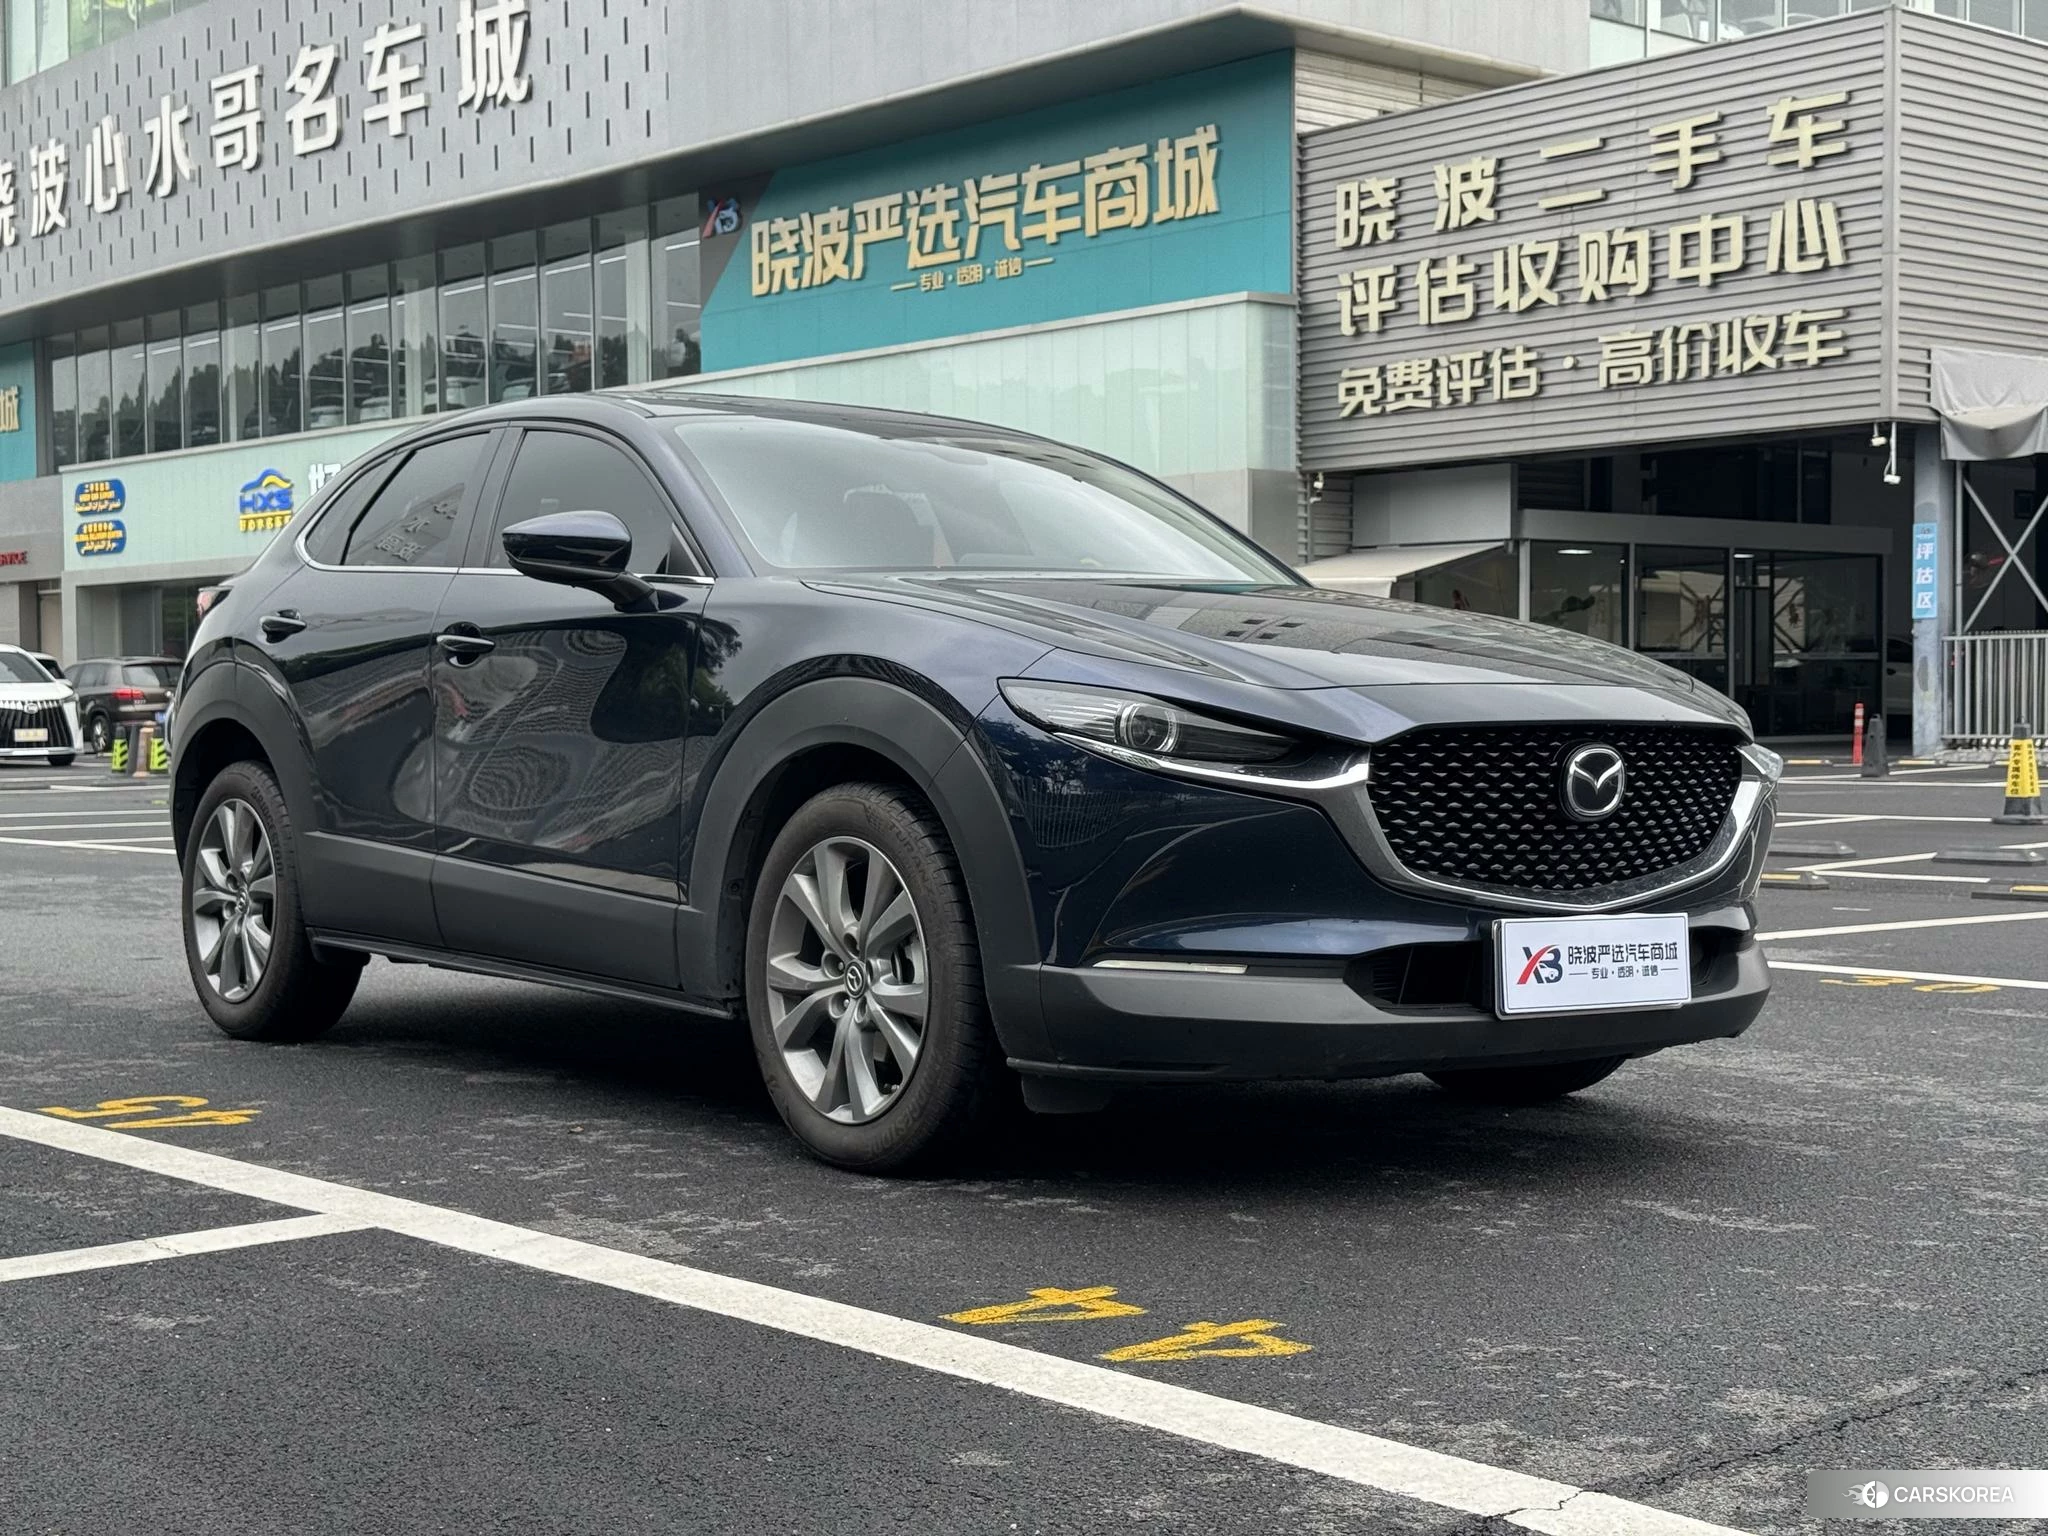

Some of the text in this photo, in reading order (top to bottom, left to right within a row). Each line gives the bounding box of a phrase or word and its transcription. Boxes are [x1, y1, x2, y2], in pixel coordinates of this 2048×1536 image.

[751, 124, 1219, 296] 晓波严选汽车商城
[1335, 91, 1850, 248] 晓波二手车
[1338, 199, 1847, 337] 评估收购中心
[240, 489, 293, 513] HXS
[1916, 542, 1934, 609] 评估区
[1567, 941, 1678, 965] 晓波严选汽车商城
